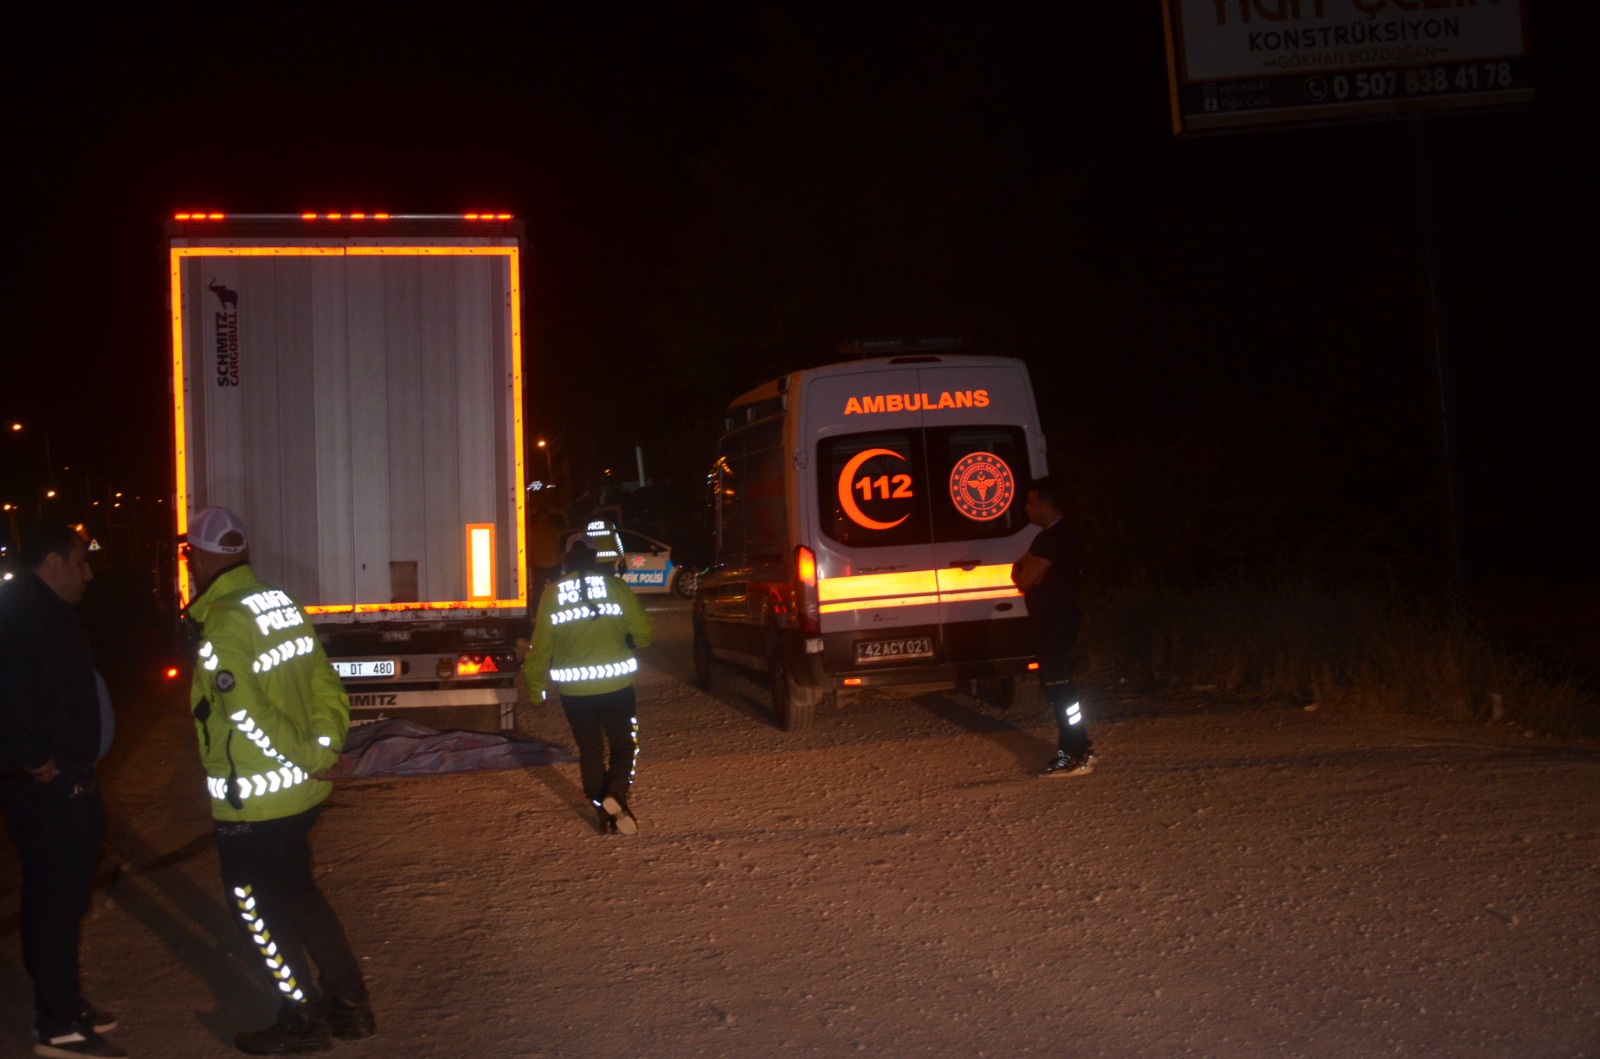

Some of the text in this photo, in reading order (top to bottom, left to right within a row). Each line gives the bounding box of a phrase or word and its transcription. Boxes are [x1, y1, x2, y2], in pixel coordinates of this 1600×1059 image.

[1249, 17, 1460, 51] KONSTRÜKSİYON
[1278, 43, 1436, 70] GÖKHAN BOZDOĞAN
[1333, 62, 1513, 99] 0 507 838 41 78
[216, 311, 229, 387] SCHMITZ
[228, 311, 239, 387] CARGOBULL
[844, 389, 990, 415] AMBULANS
[855, 474, 913, 501] 112
[639, 571, 664, 584] POLİSİ
[558, 586, 607, 606] POİSİ
[865, 643, 881, 657] 42
[882, 641, 905, 656] ACY
[906, 639, 929, 654] 021
[350, 663, 363, 675] DT
[373, 662, 392, 674] 480
